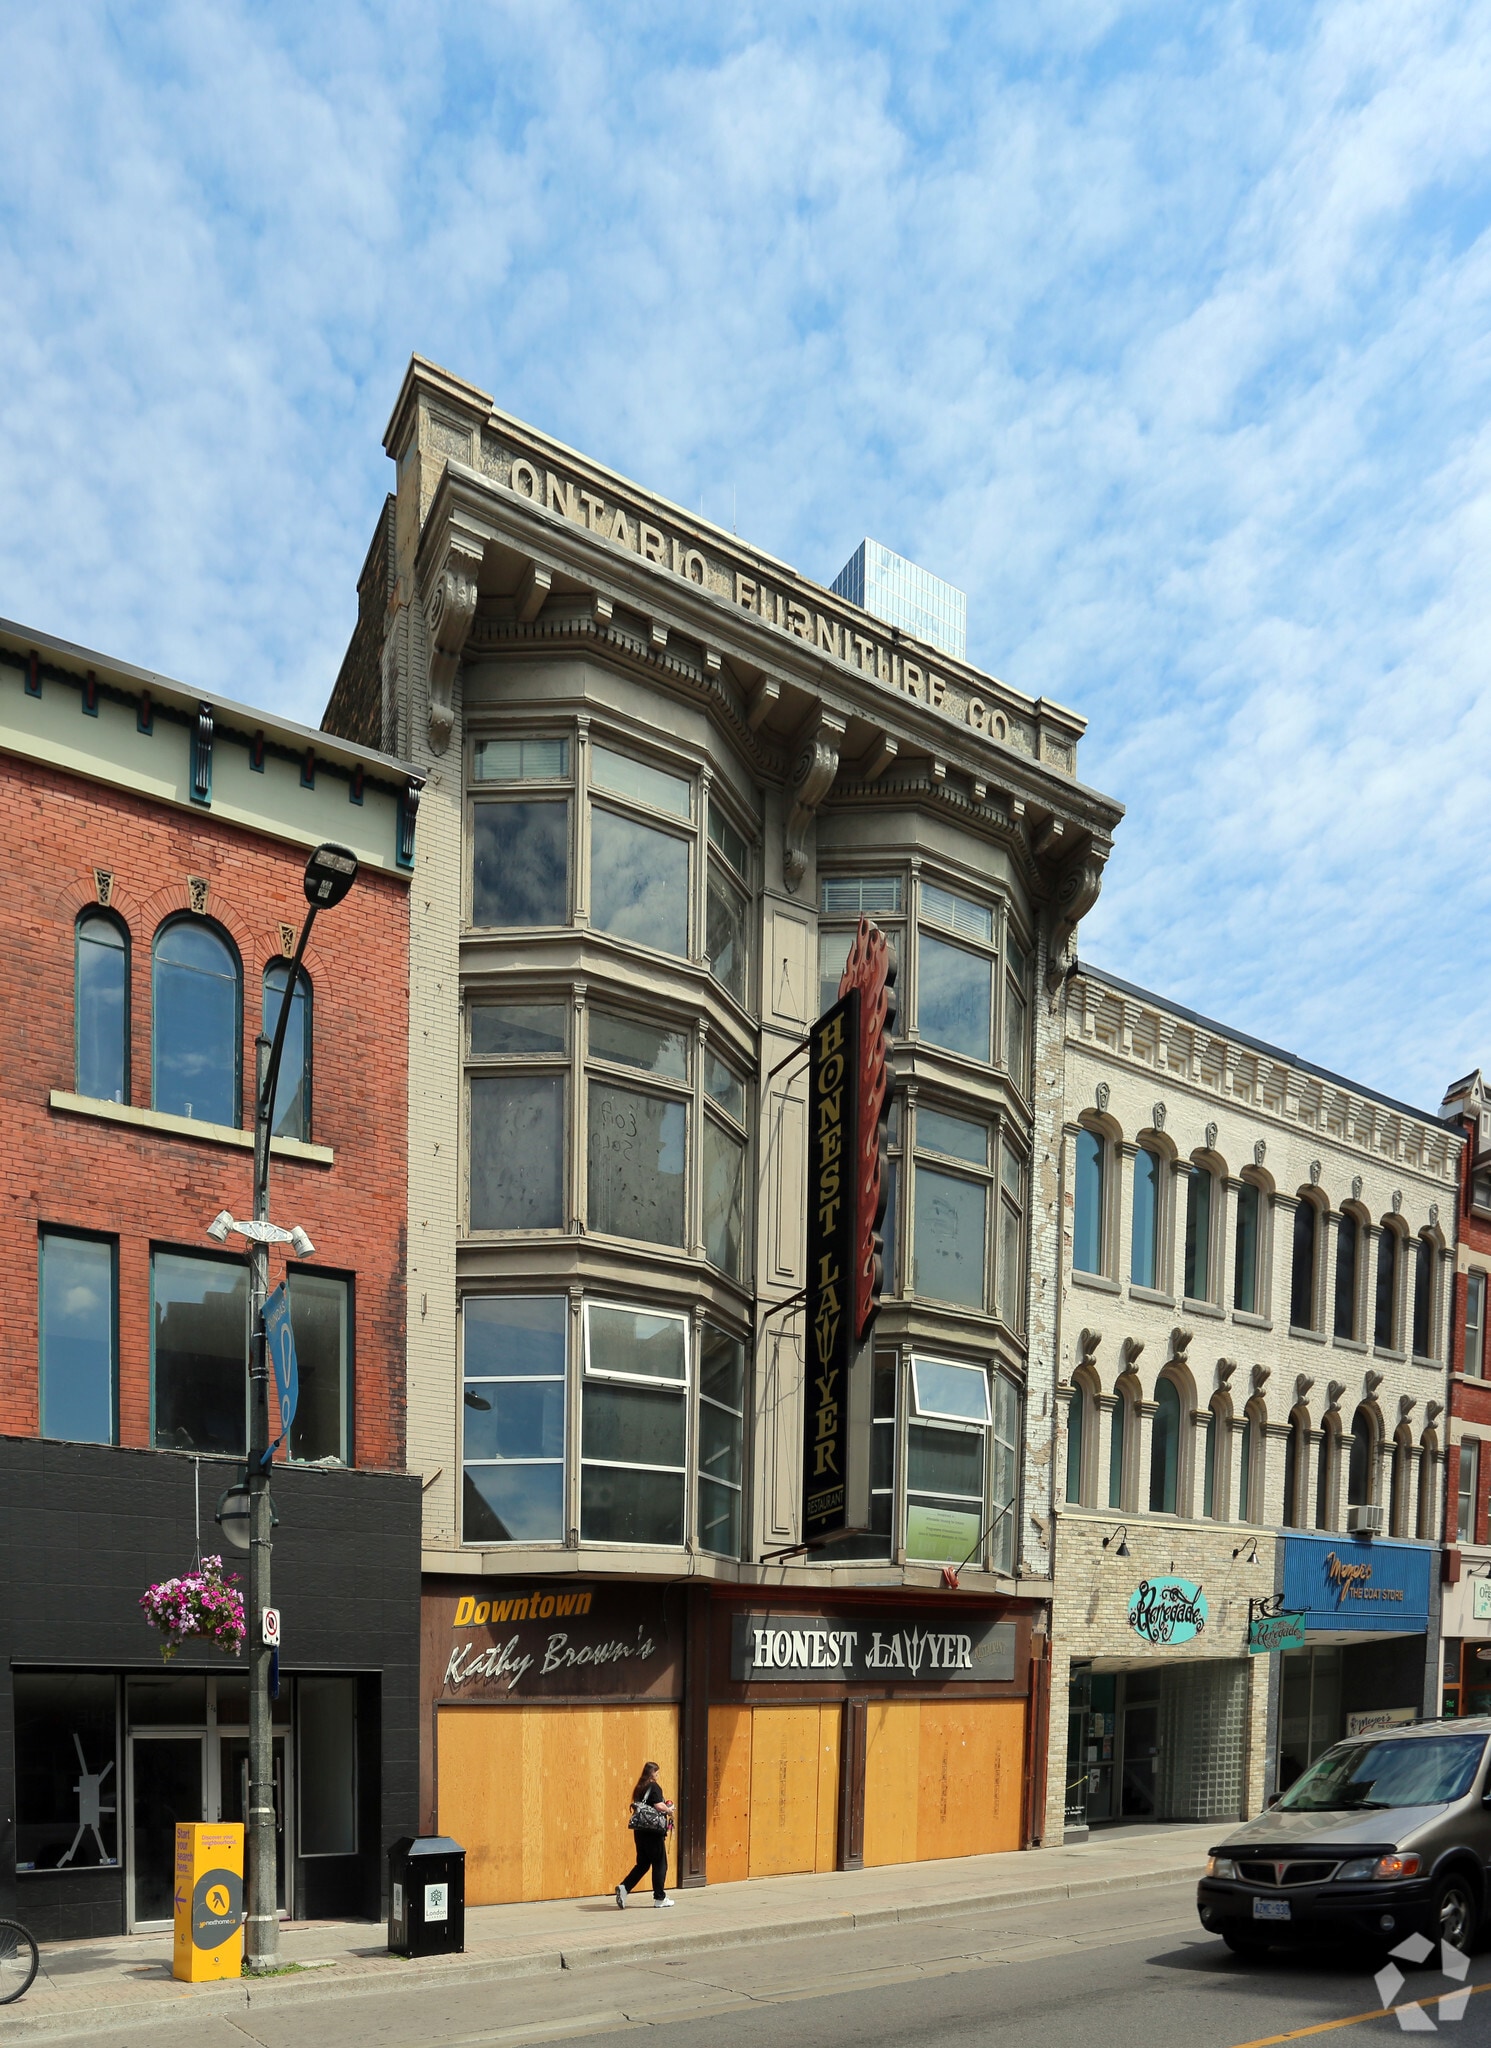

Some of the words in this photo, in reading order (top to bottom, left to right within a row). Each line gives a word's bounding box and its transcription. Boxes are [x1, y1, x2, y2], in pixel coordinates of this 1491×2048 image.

[511, 457, 709, 589] ONTARIO
[967, 696, 1010, 741] CO
[818, 1011, 845, 1238] HONEST
[813, 1252, 841, 1477] LAWYER
[453, 1591, 592, 1626] Downtown
[1129, 1580, 1204, 1642] Renegade
[1350, 1587, 1363, 1598] THE
[1364, 1588, 1381, 1599] COAT
[1382, 1589, 1404, 1601] STORE
[443, 1634, 534, 1690] Kathy
[539, 1624, 656, 1675] Brown's
[752, 1629, 857, 1668] HONEST
[865, 1625, 973, 1677] LAWYER
[177, 1828, 190, 1840] Start
[177, 1852, 193, 1862] search
[426, 1909, 447, 1917] London
